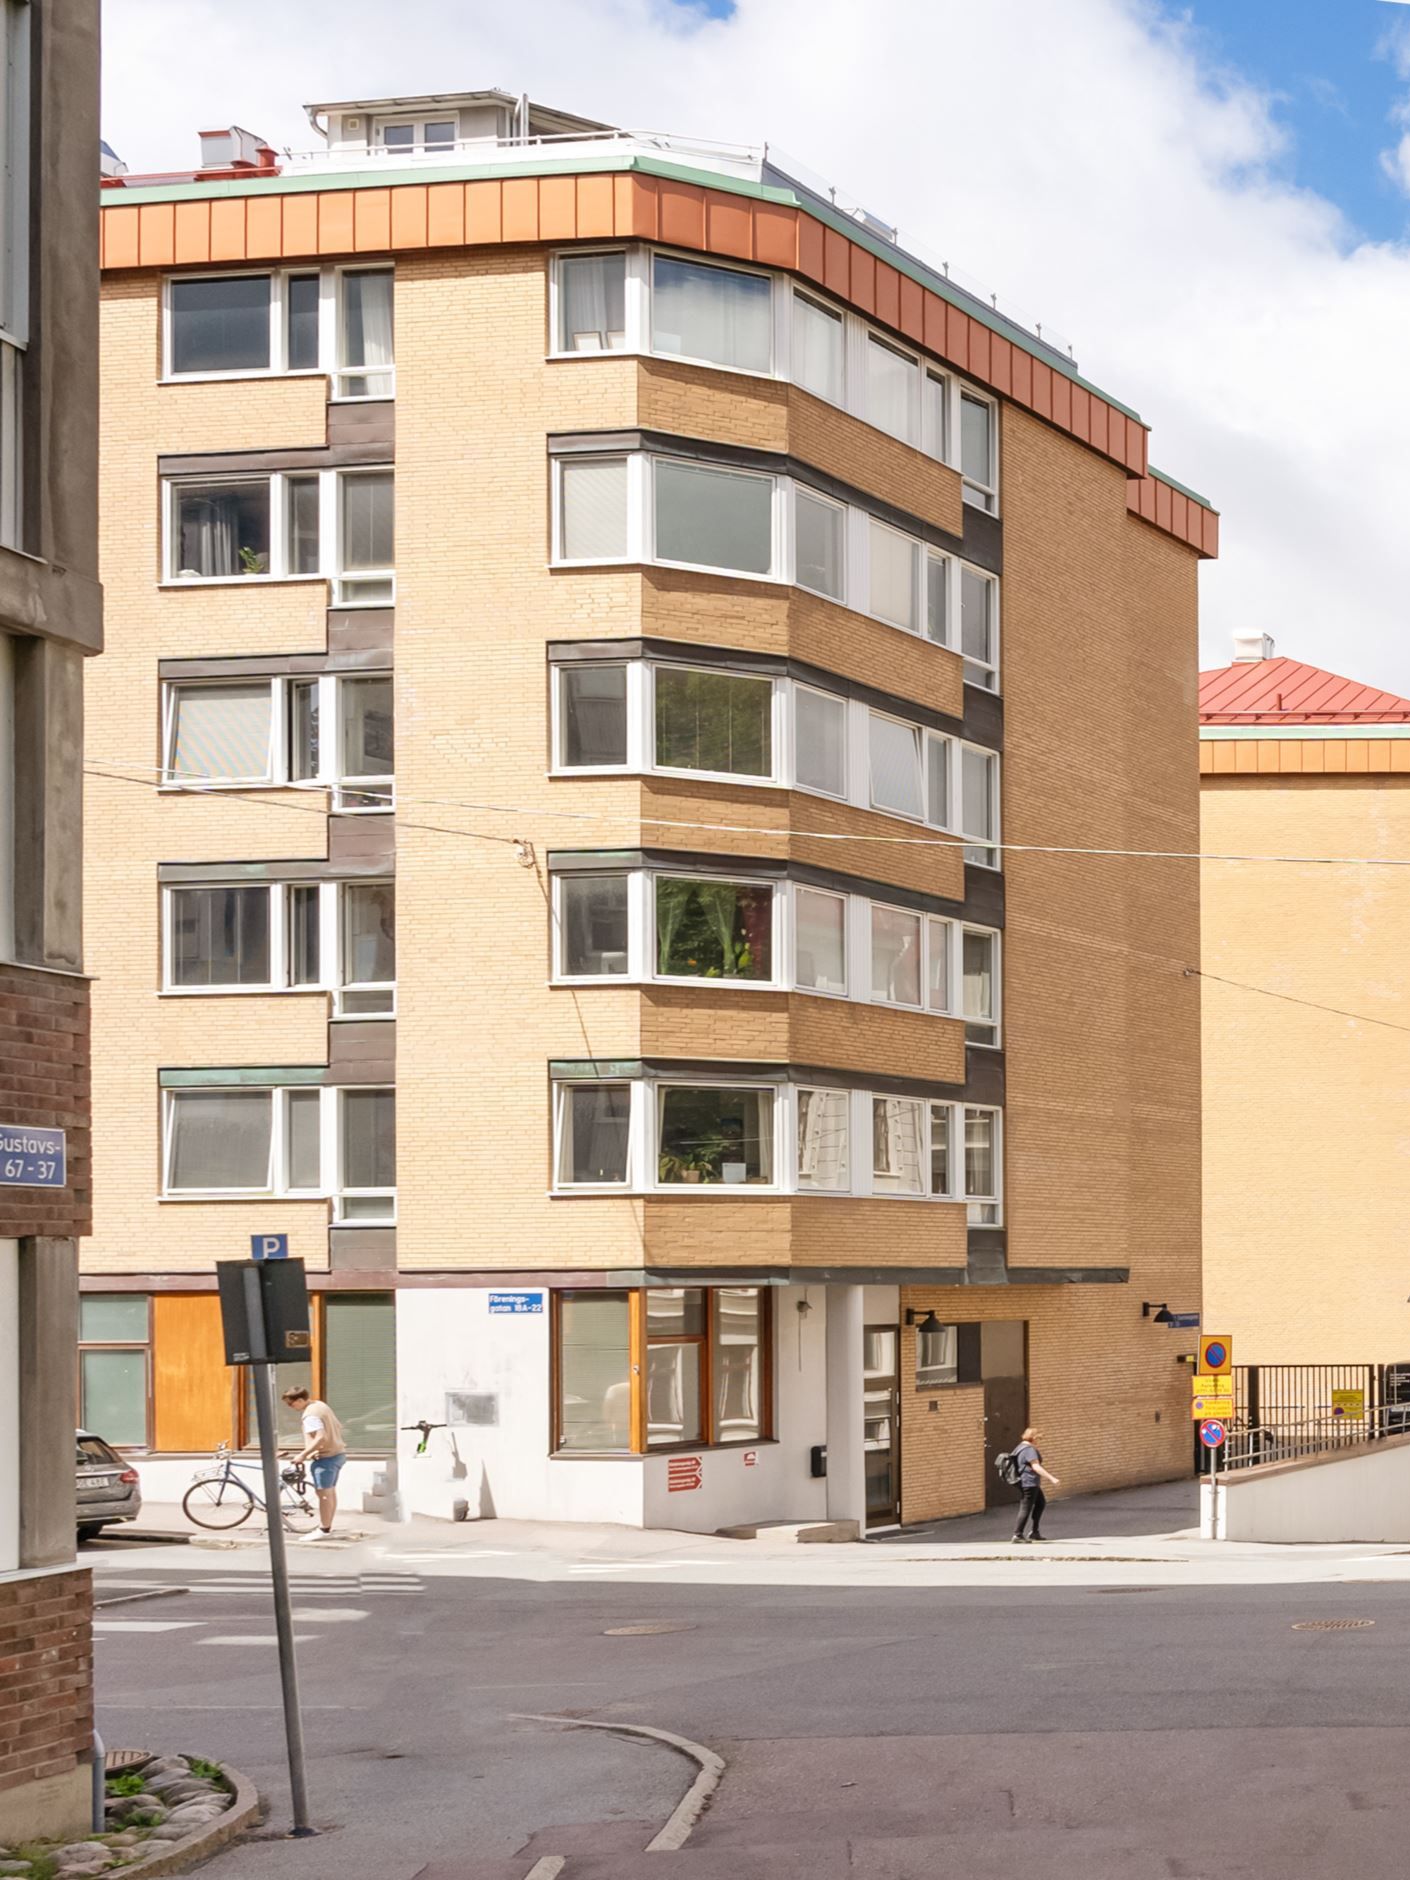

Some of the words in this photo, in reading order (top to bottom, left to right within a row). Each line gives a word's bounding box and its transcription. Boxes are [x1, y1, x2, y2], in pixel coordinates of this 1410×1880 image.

[5, 1159, 24, 1178] 67
[37, 1161, 56, 1179] 37
[262, 1237, 280, 1259] P
